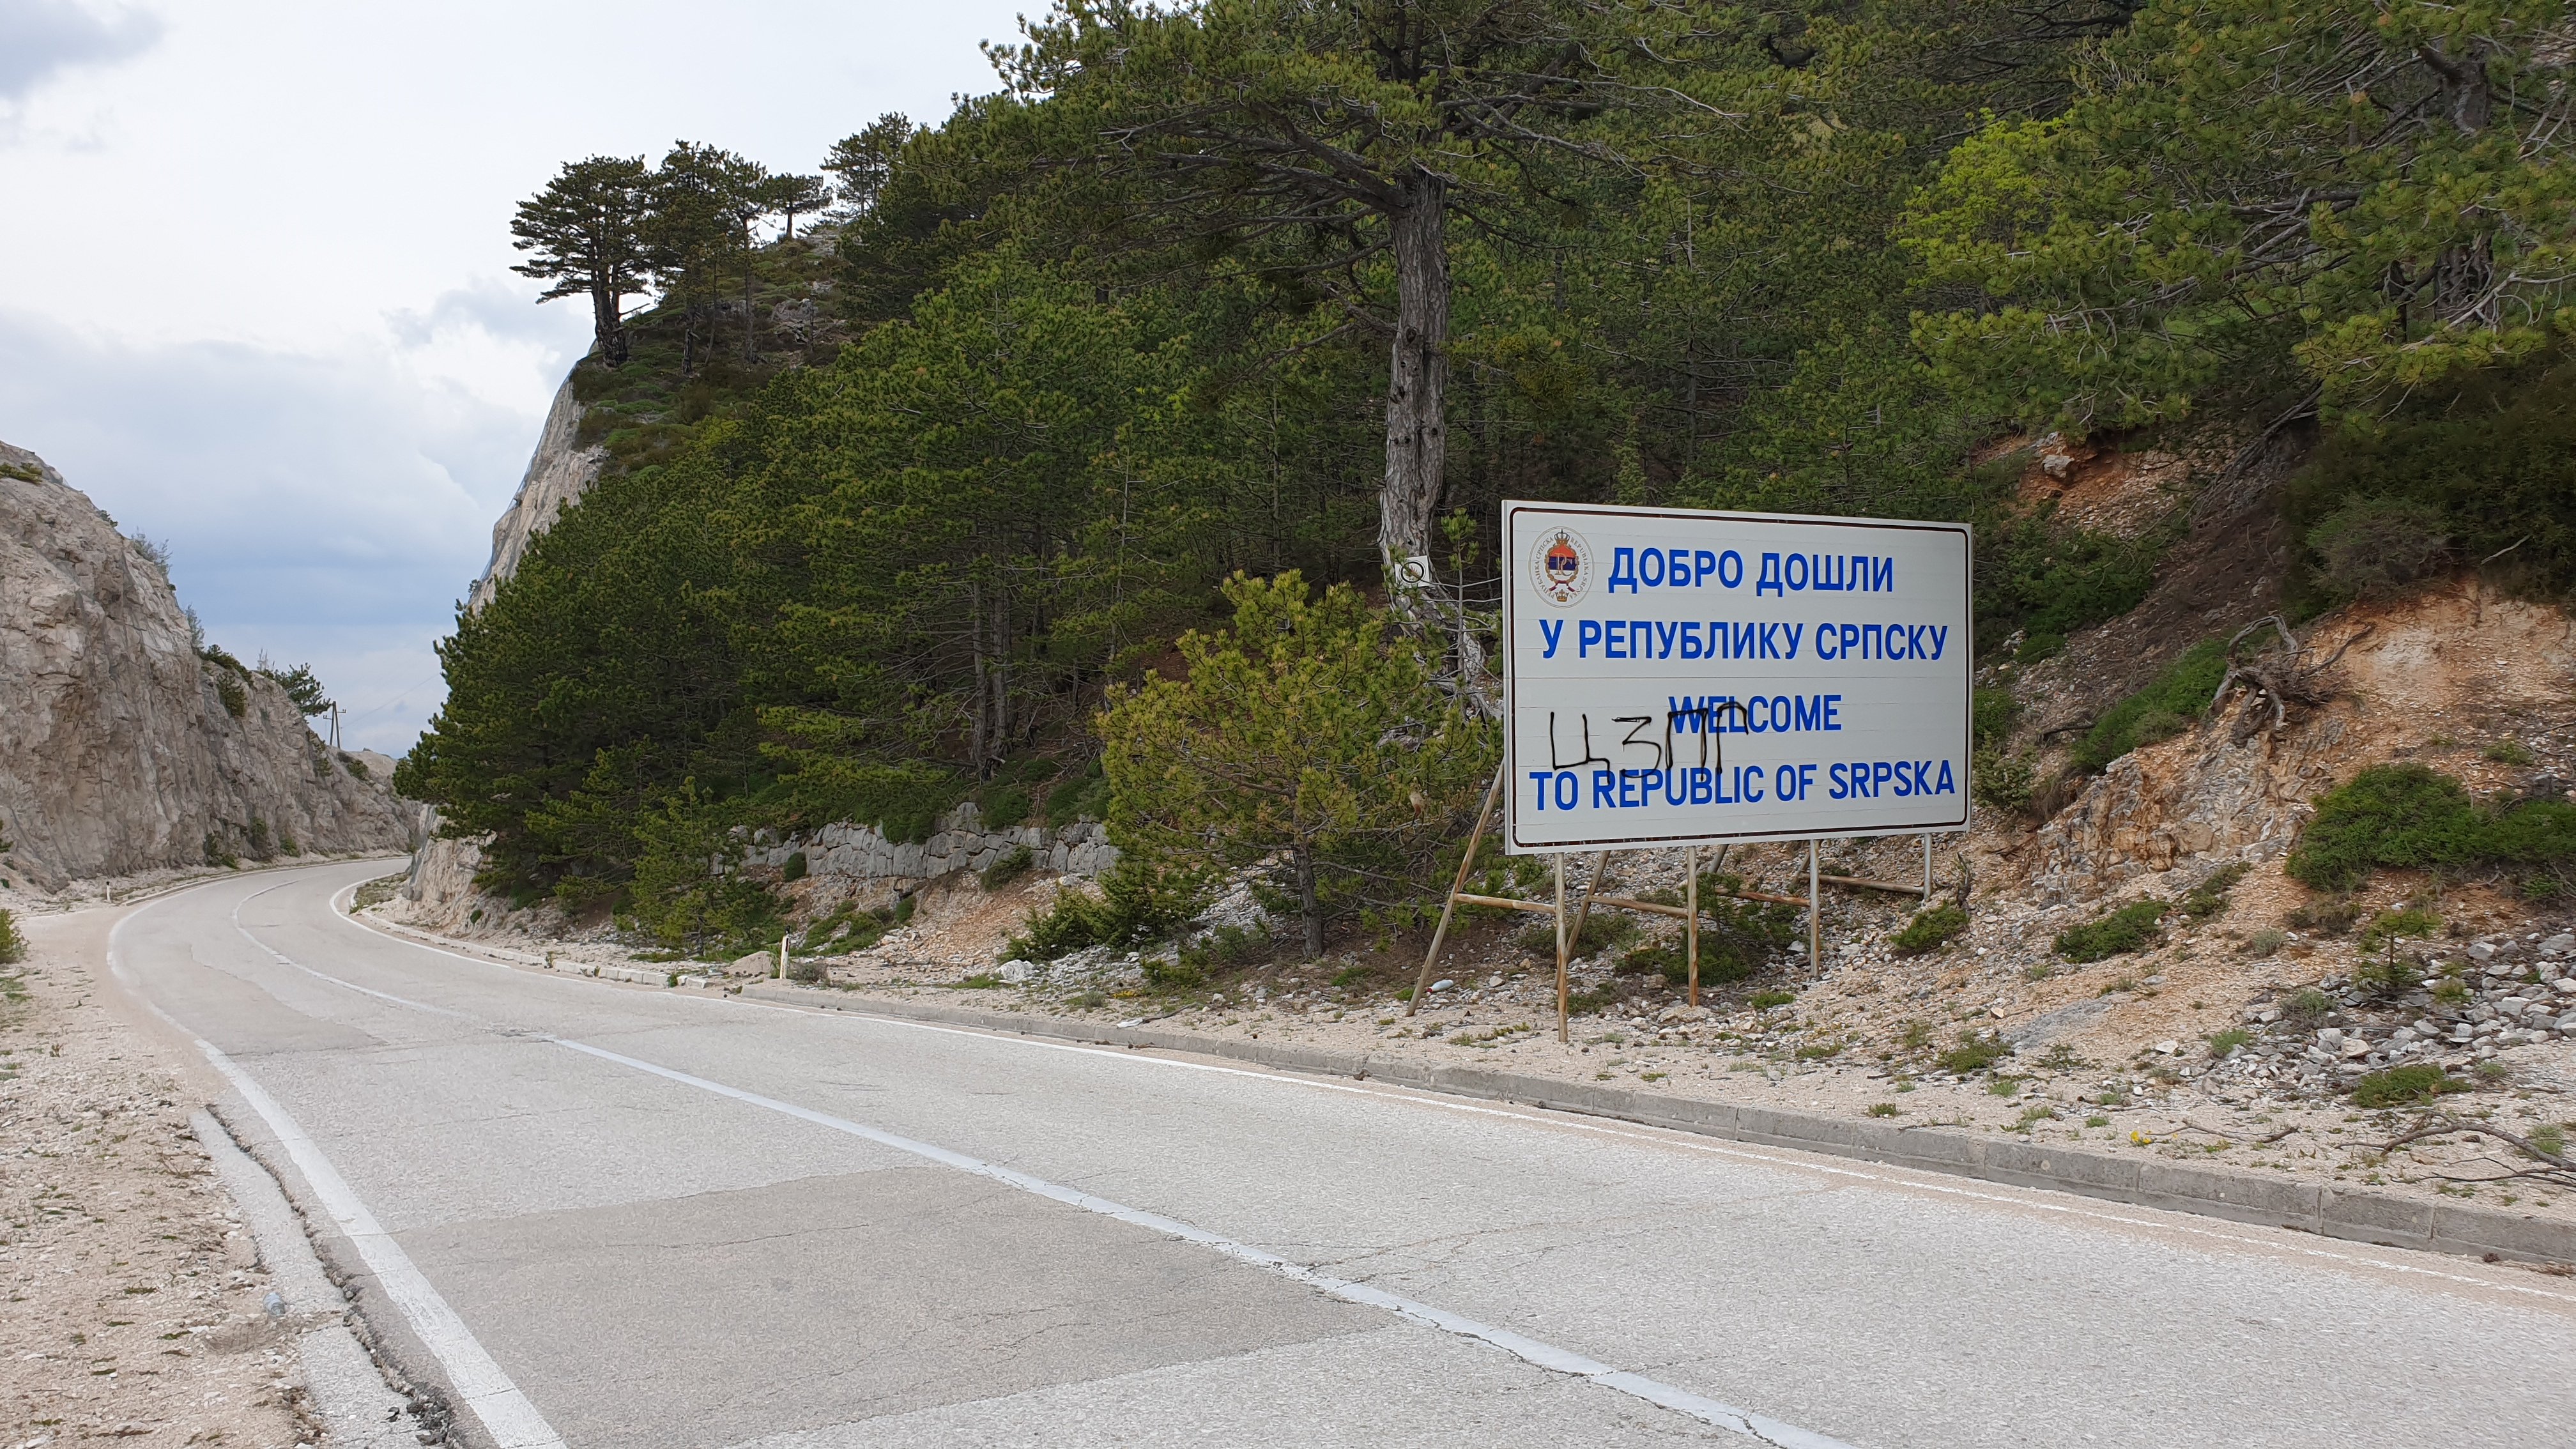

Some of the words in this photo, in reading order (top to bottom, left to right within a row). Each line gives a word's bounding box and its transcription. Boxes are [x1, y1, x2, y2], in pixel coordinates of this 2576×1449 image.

[1608, 546, 1744, 594] ДОБРО
[1756, 552, 1894, 598] ДОШЛИ
[1539, 619, 1564, 659] У
[1579, 620, 1804, 661] РЕПУБЛИКУ
[1816, 624, 1949, 661] СРПСКУ
[1668, 694, 1843, 734] WELCOME
[1529, 770, 1580, 811] TO
[1592, 765, 1766, 809] REPUBLIC
[1776, 763, 1819, 802] OF
[1829, 760, 1956, 801] SRPSKA
